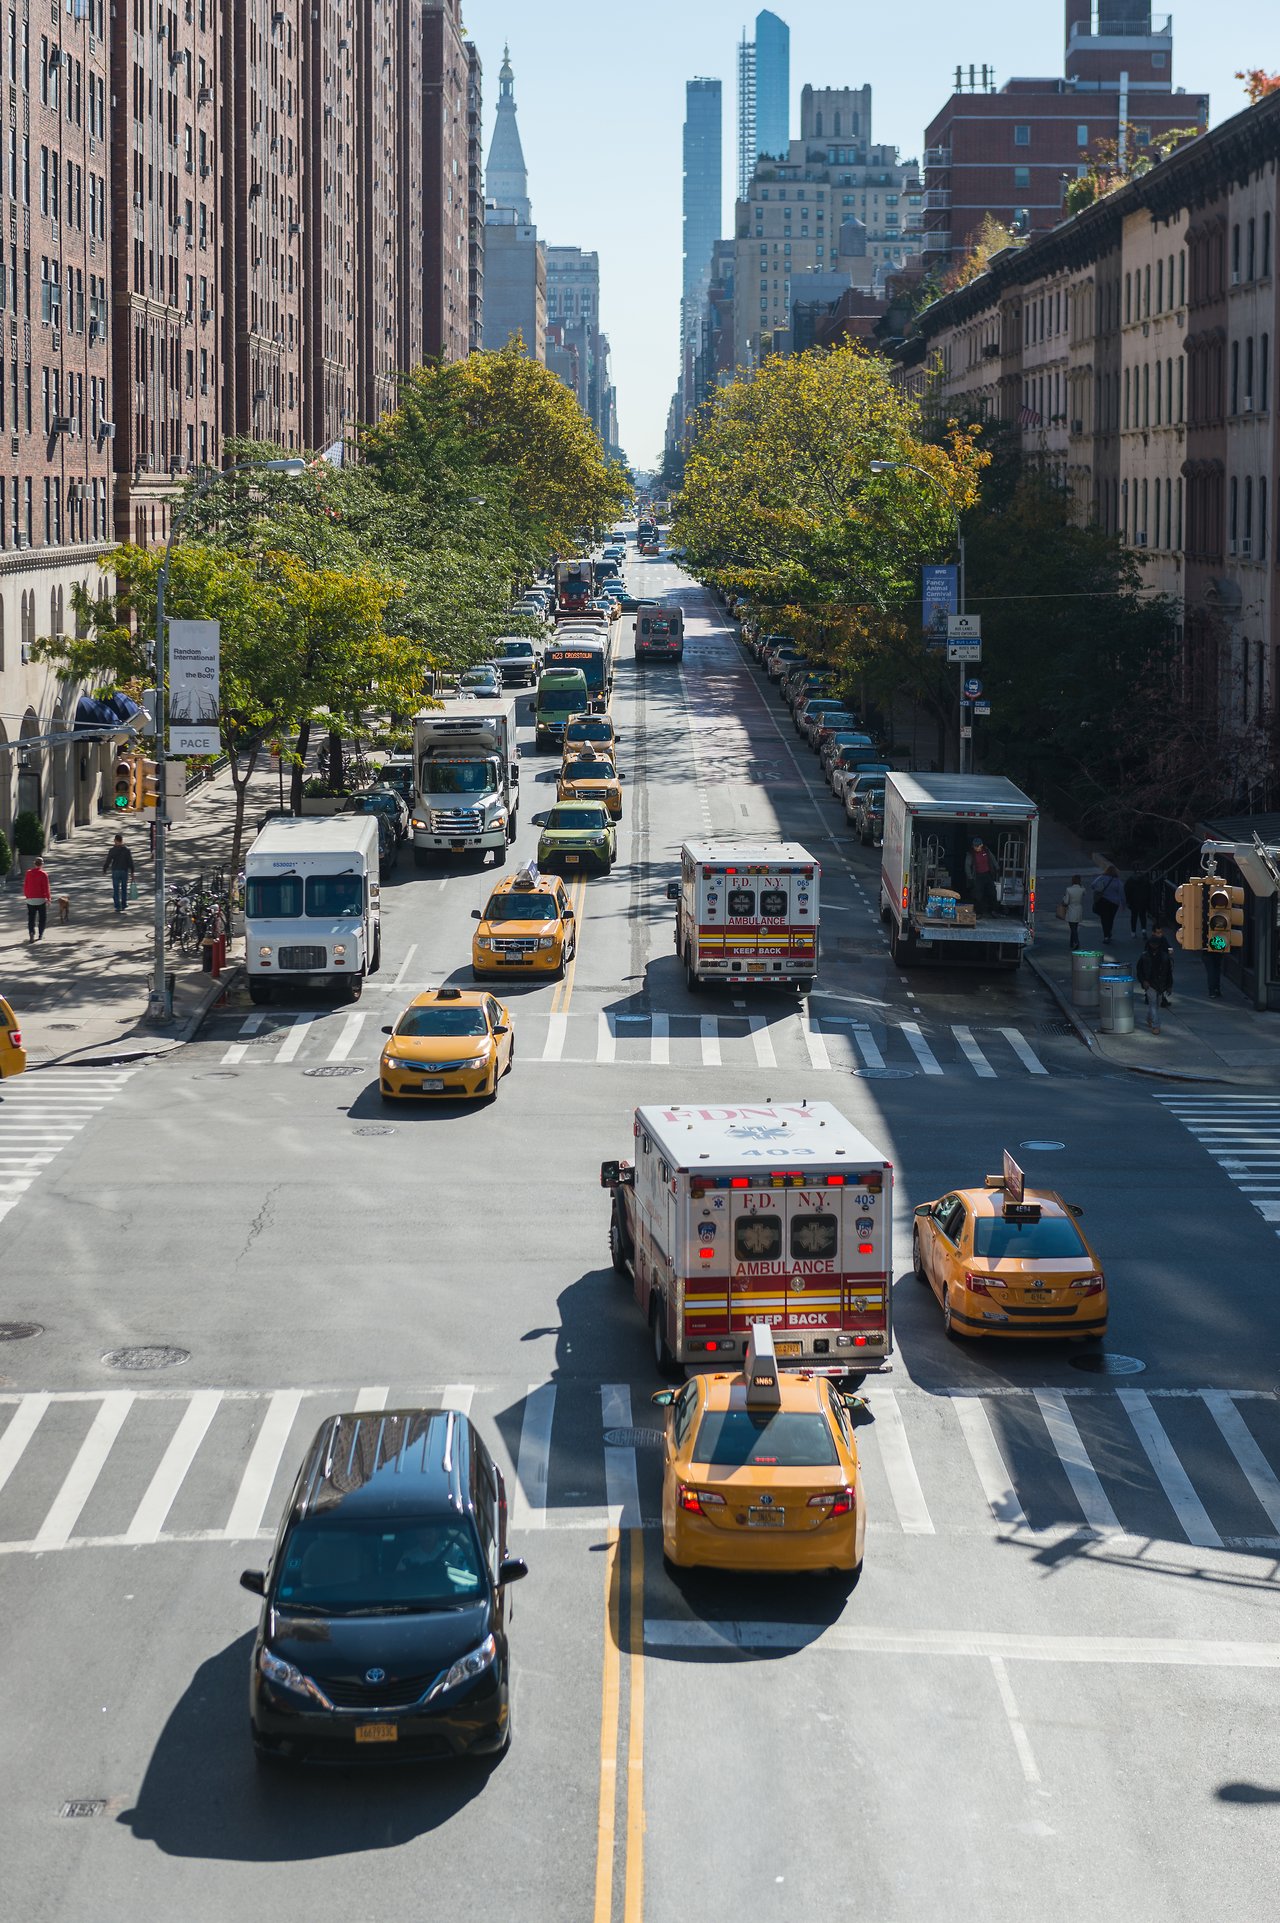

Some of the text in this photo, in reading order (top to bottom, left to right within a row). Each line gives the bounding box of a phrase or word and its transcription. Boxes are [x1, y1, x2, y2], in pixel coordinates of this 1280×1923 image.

[197, 672, 215, 680] Body
[180, 739, 210, 748] PACE
[732, 878, 784, 888] F.D. N.Y.
[728, 917, 786, 925] AMBULANCE
[661, 1107, 817, 1122] FDNY
[740, 1148, 816, 1156] 403
[743, 1192, 831, 1209] F.D. N.Y.
[854, 1195, 876, 1205] 403
[736, 1260, 835, 1276] AMBULANCE
[745, 1313, 828, 1326] KEEP BACK
[755, 1376, 774, 1386] 3N65
